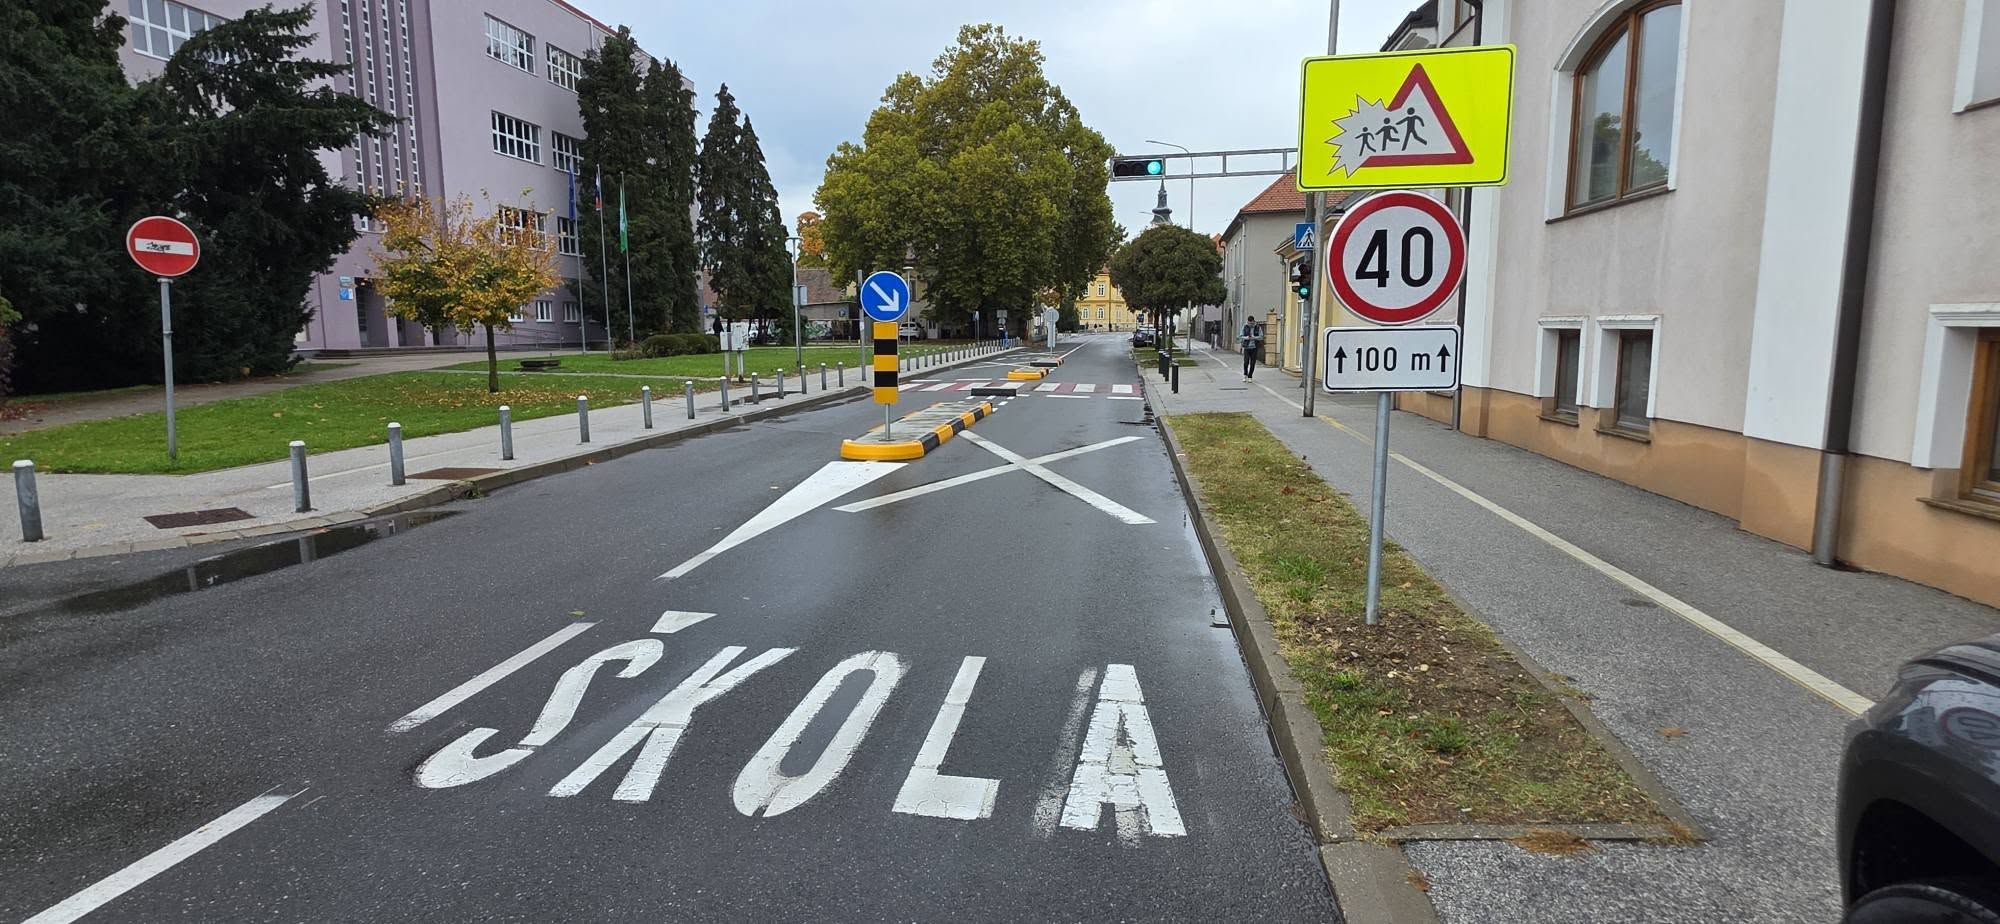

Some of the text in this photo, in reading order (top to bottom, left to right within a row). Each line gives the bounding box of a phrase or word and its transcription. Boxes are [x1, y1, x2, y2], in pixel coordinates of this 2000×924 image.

[1355, 227, 1434, 288] 40
[1356, 346, 1431, 372] 100 m
[414, 611, 1187, 838] ŠKOLA
